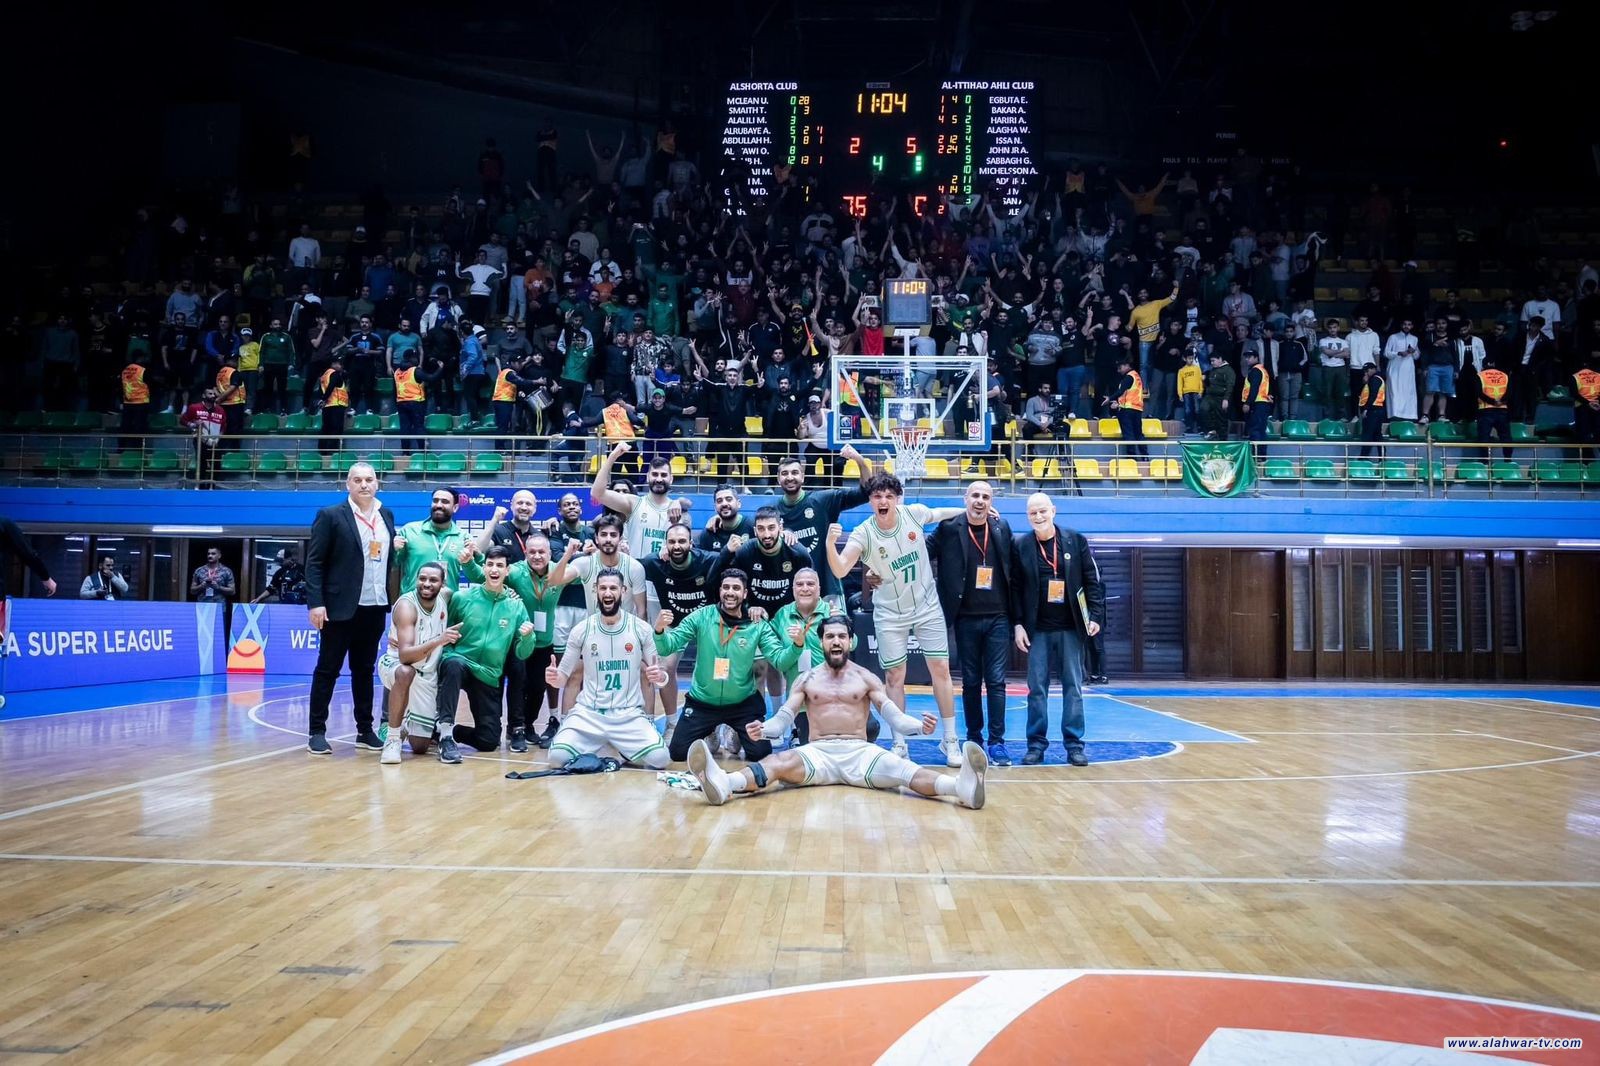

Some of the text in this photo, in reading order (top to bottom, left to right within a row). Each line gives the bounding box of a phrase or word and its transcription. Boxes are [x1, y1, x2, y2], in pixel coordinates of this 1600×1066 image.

[790, 96, 796, 104] 0
[799, 96, 810, 104] 28
[858, 94, 906, 113] 11:04
[952, 96, 958, 104] 4
[965, 95, 972, 104] 0
[804, 106, 810, 114] 3
[790, 116, 796, 124] 3
[938, 115, 944, 124] 4
[952, 115, 958, 124] 5
[965, 115, 972, 124] 2
[790, 126, 796, 134] 5
[803, 126, 810, 134] 2
[966, 126, 972, 134] 3
[803, 136, 810, 144] 8
[938, 135, 944, 144] 2
[950, 135, 958, 144] 12
[966, 136, 972, 144] 4
[790, 146, 796, 154] 8
[850, 138, 860, 154] 2
[906, 138, 916, 154] 5
[946, 145, 958, 154] 24
[966, 145, 972, 154] 5
[788, 156, 796, 164] 12
[801, 156, 809, 164] 13
[872, 156, 884, 171] 4
[952, 175, 958, 184] 2
[894, 282, 926, 294] 11:04
[651, 540, 662, 552] 15
[892, 550, 920, 572] AL-SHORTA
[902, 564, 916, 584] 77
[751, 578, 790, 589] AL-SHORTA
[668, 591, 706, 600] AL-SHORTA
[28, 631, 98, 656] SUPER
[104, 629, 174, 653] LEAGUE
[598, 660, 629, 672] AL-SHORTA
[604, 673, 622, 691] 24
